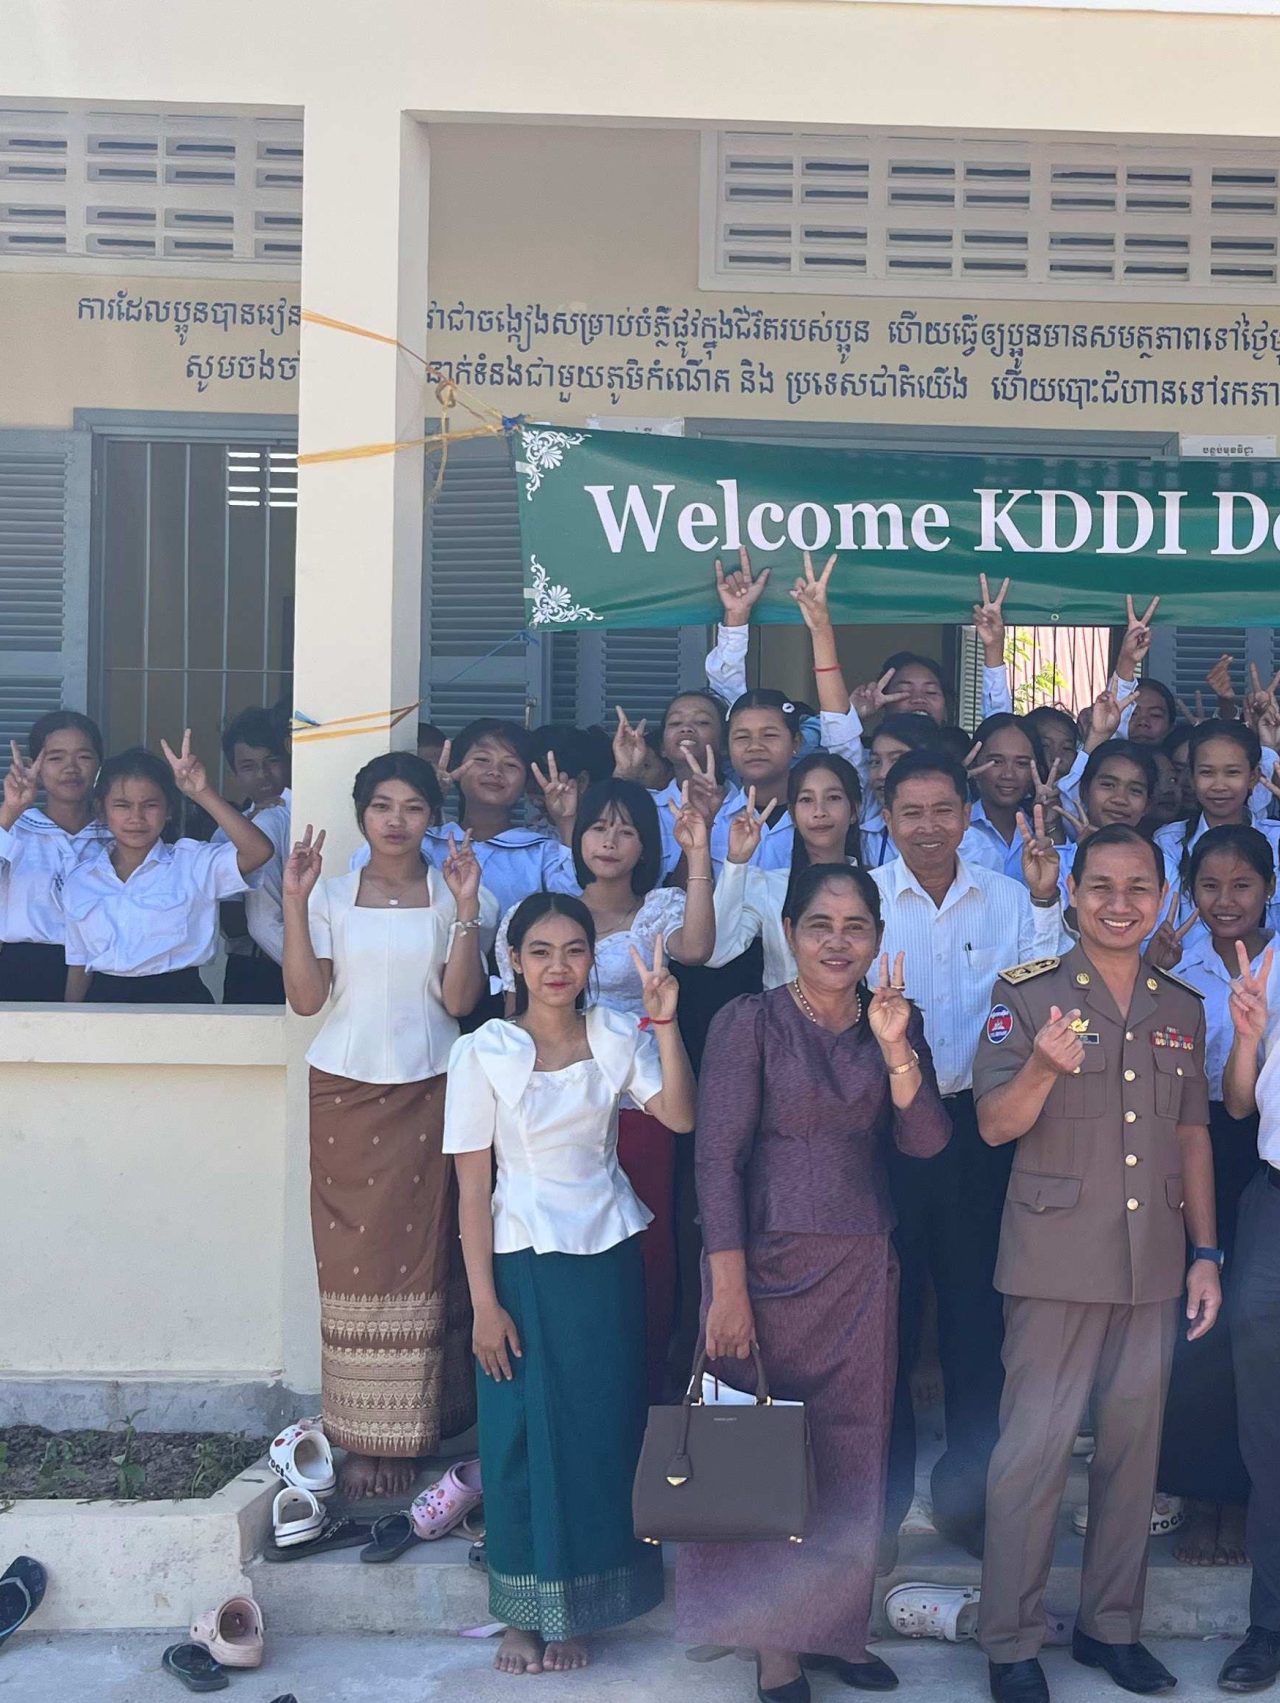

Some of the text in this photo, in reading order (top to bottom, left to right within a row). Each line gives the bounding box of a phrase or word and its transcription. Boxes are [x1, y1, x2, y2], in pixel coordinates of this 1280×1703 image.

[740, 359, 774, 394] និង
[583, 478, 951, 553] Welcome
[972, 488, 1188, 555] KDDI
